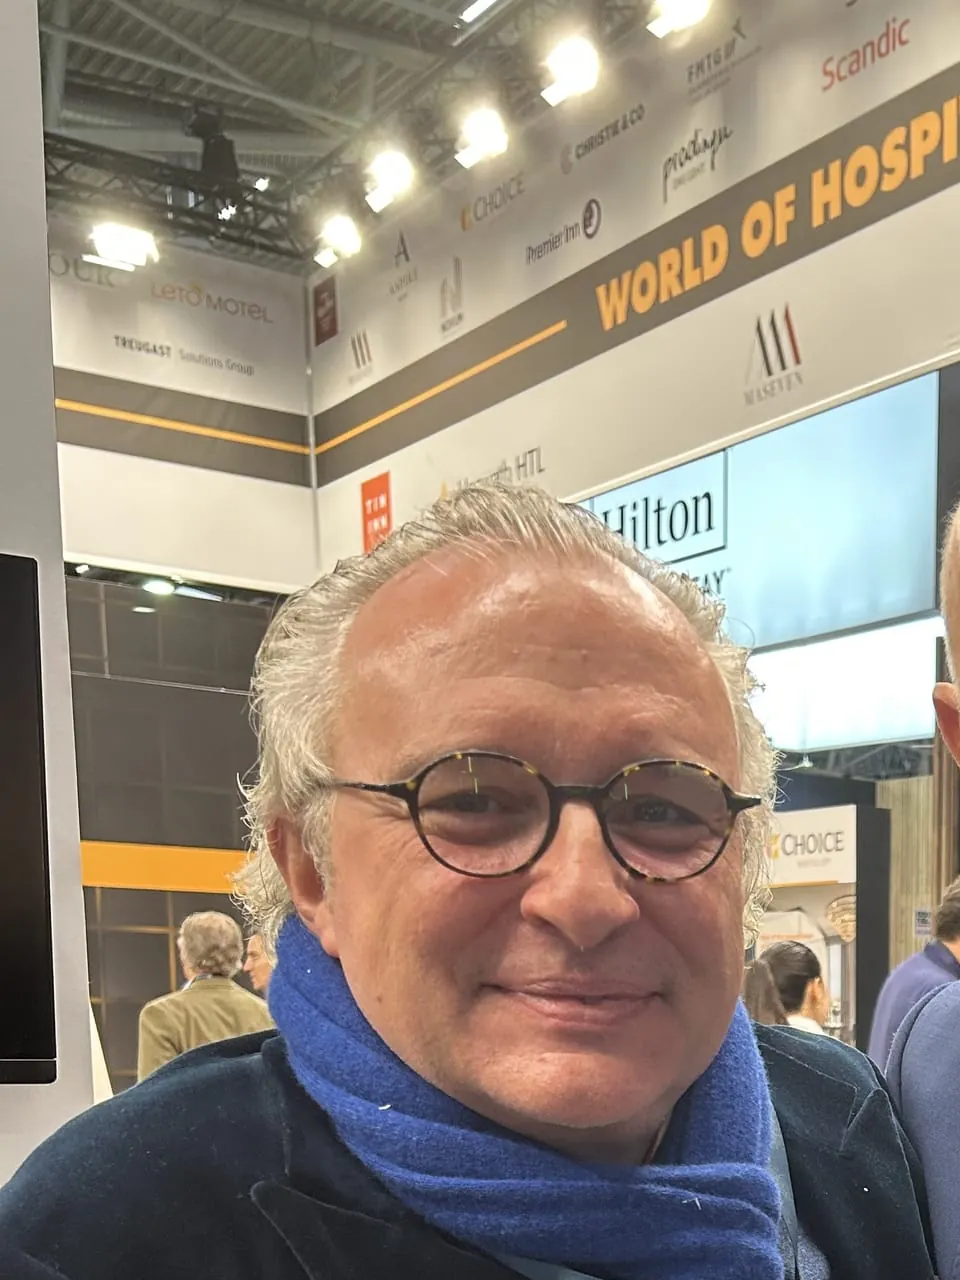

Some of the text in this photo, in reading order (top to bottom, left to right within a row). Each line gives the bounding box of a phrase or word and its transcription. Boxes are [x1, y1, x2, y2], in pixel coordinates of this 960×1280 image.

[821, 16, 911, 94] Scandic
[472, 172, 526, 222] CHOICE
[525, 221, 582, 266] Premier Inn
[596, 224, 729, 332] WORLD
[741, 184, 797, 259] OF
[514, 446, 546, 480] HTL
[602, 491, 716, 551] Hilton
[782, 831, 845, 857] CHOICE
